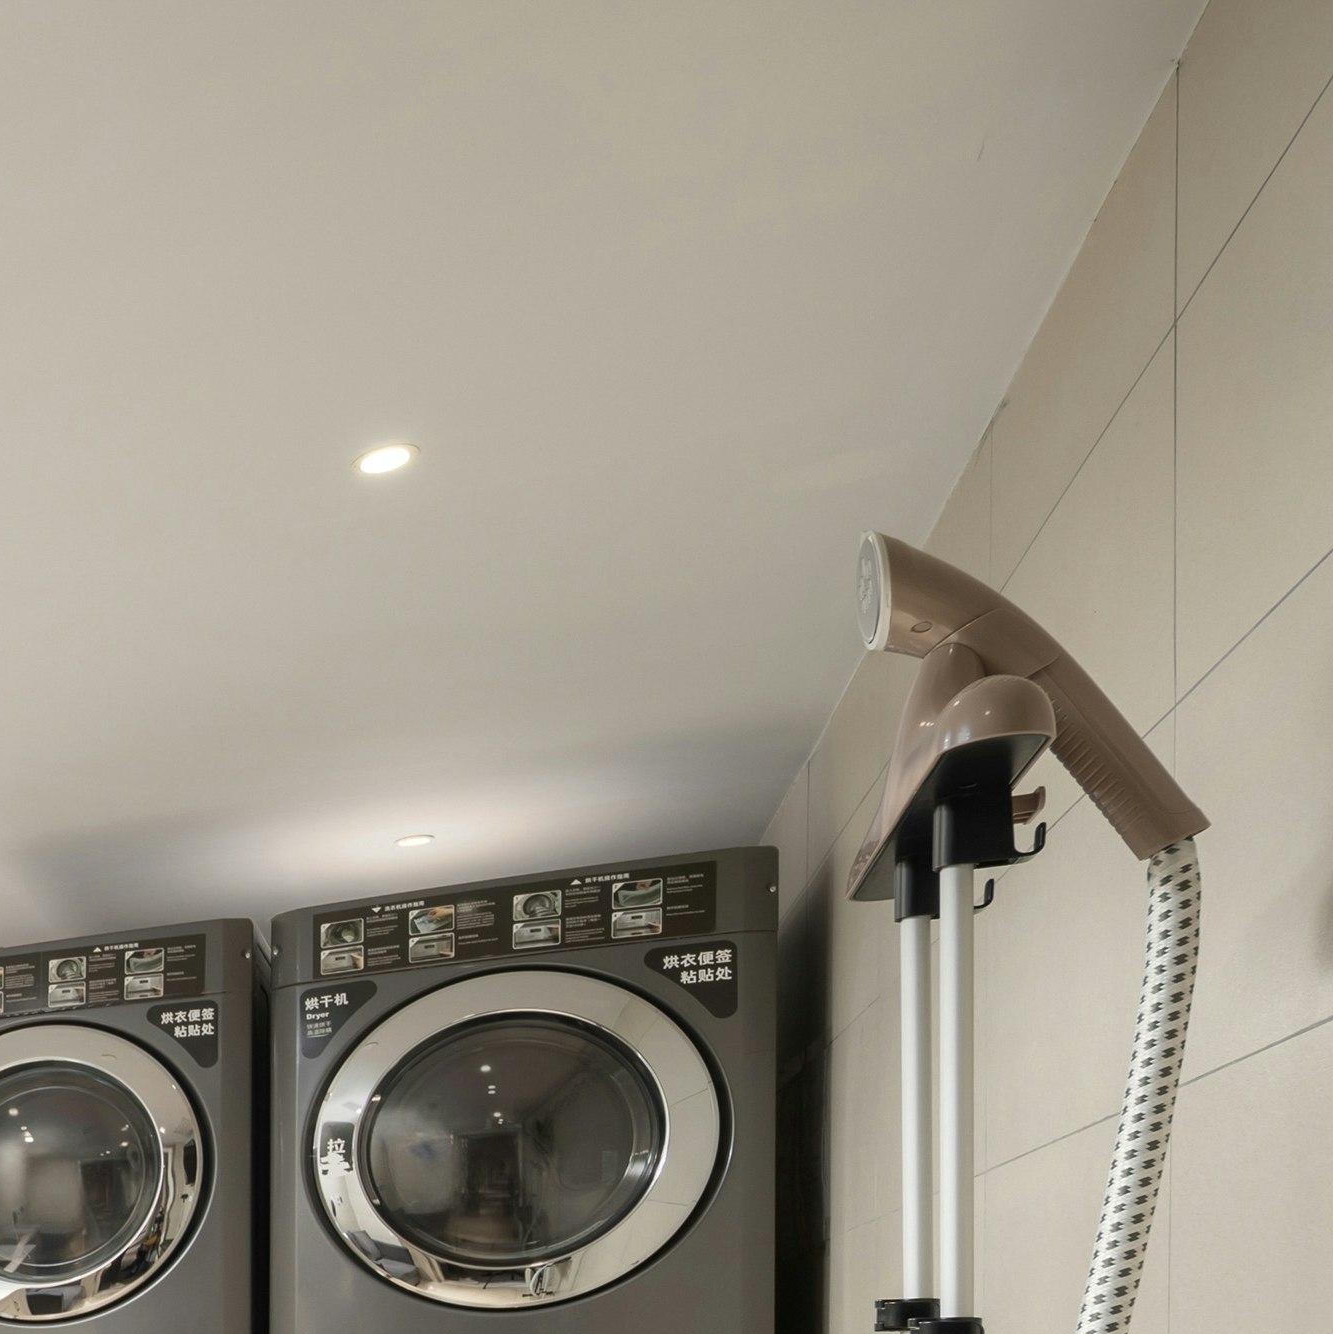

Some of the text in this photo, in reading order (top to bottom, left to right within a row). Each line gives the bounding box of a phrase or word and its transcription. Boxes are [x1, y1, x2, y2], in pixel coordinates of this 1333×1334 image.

[662, 948, 733, 970] 烘衣便签
[680, 966, 733, 985] 粘贴处
[304, 993, 349, 1011] 烘干机
[161, 1007, 215, 1025] 烘衣便签
[306, 1012, 330, 1021] Dryer
[174, 1023, 215, 1038] 粘贴处
[327, 1138, 346, 1153] 拉
